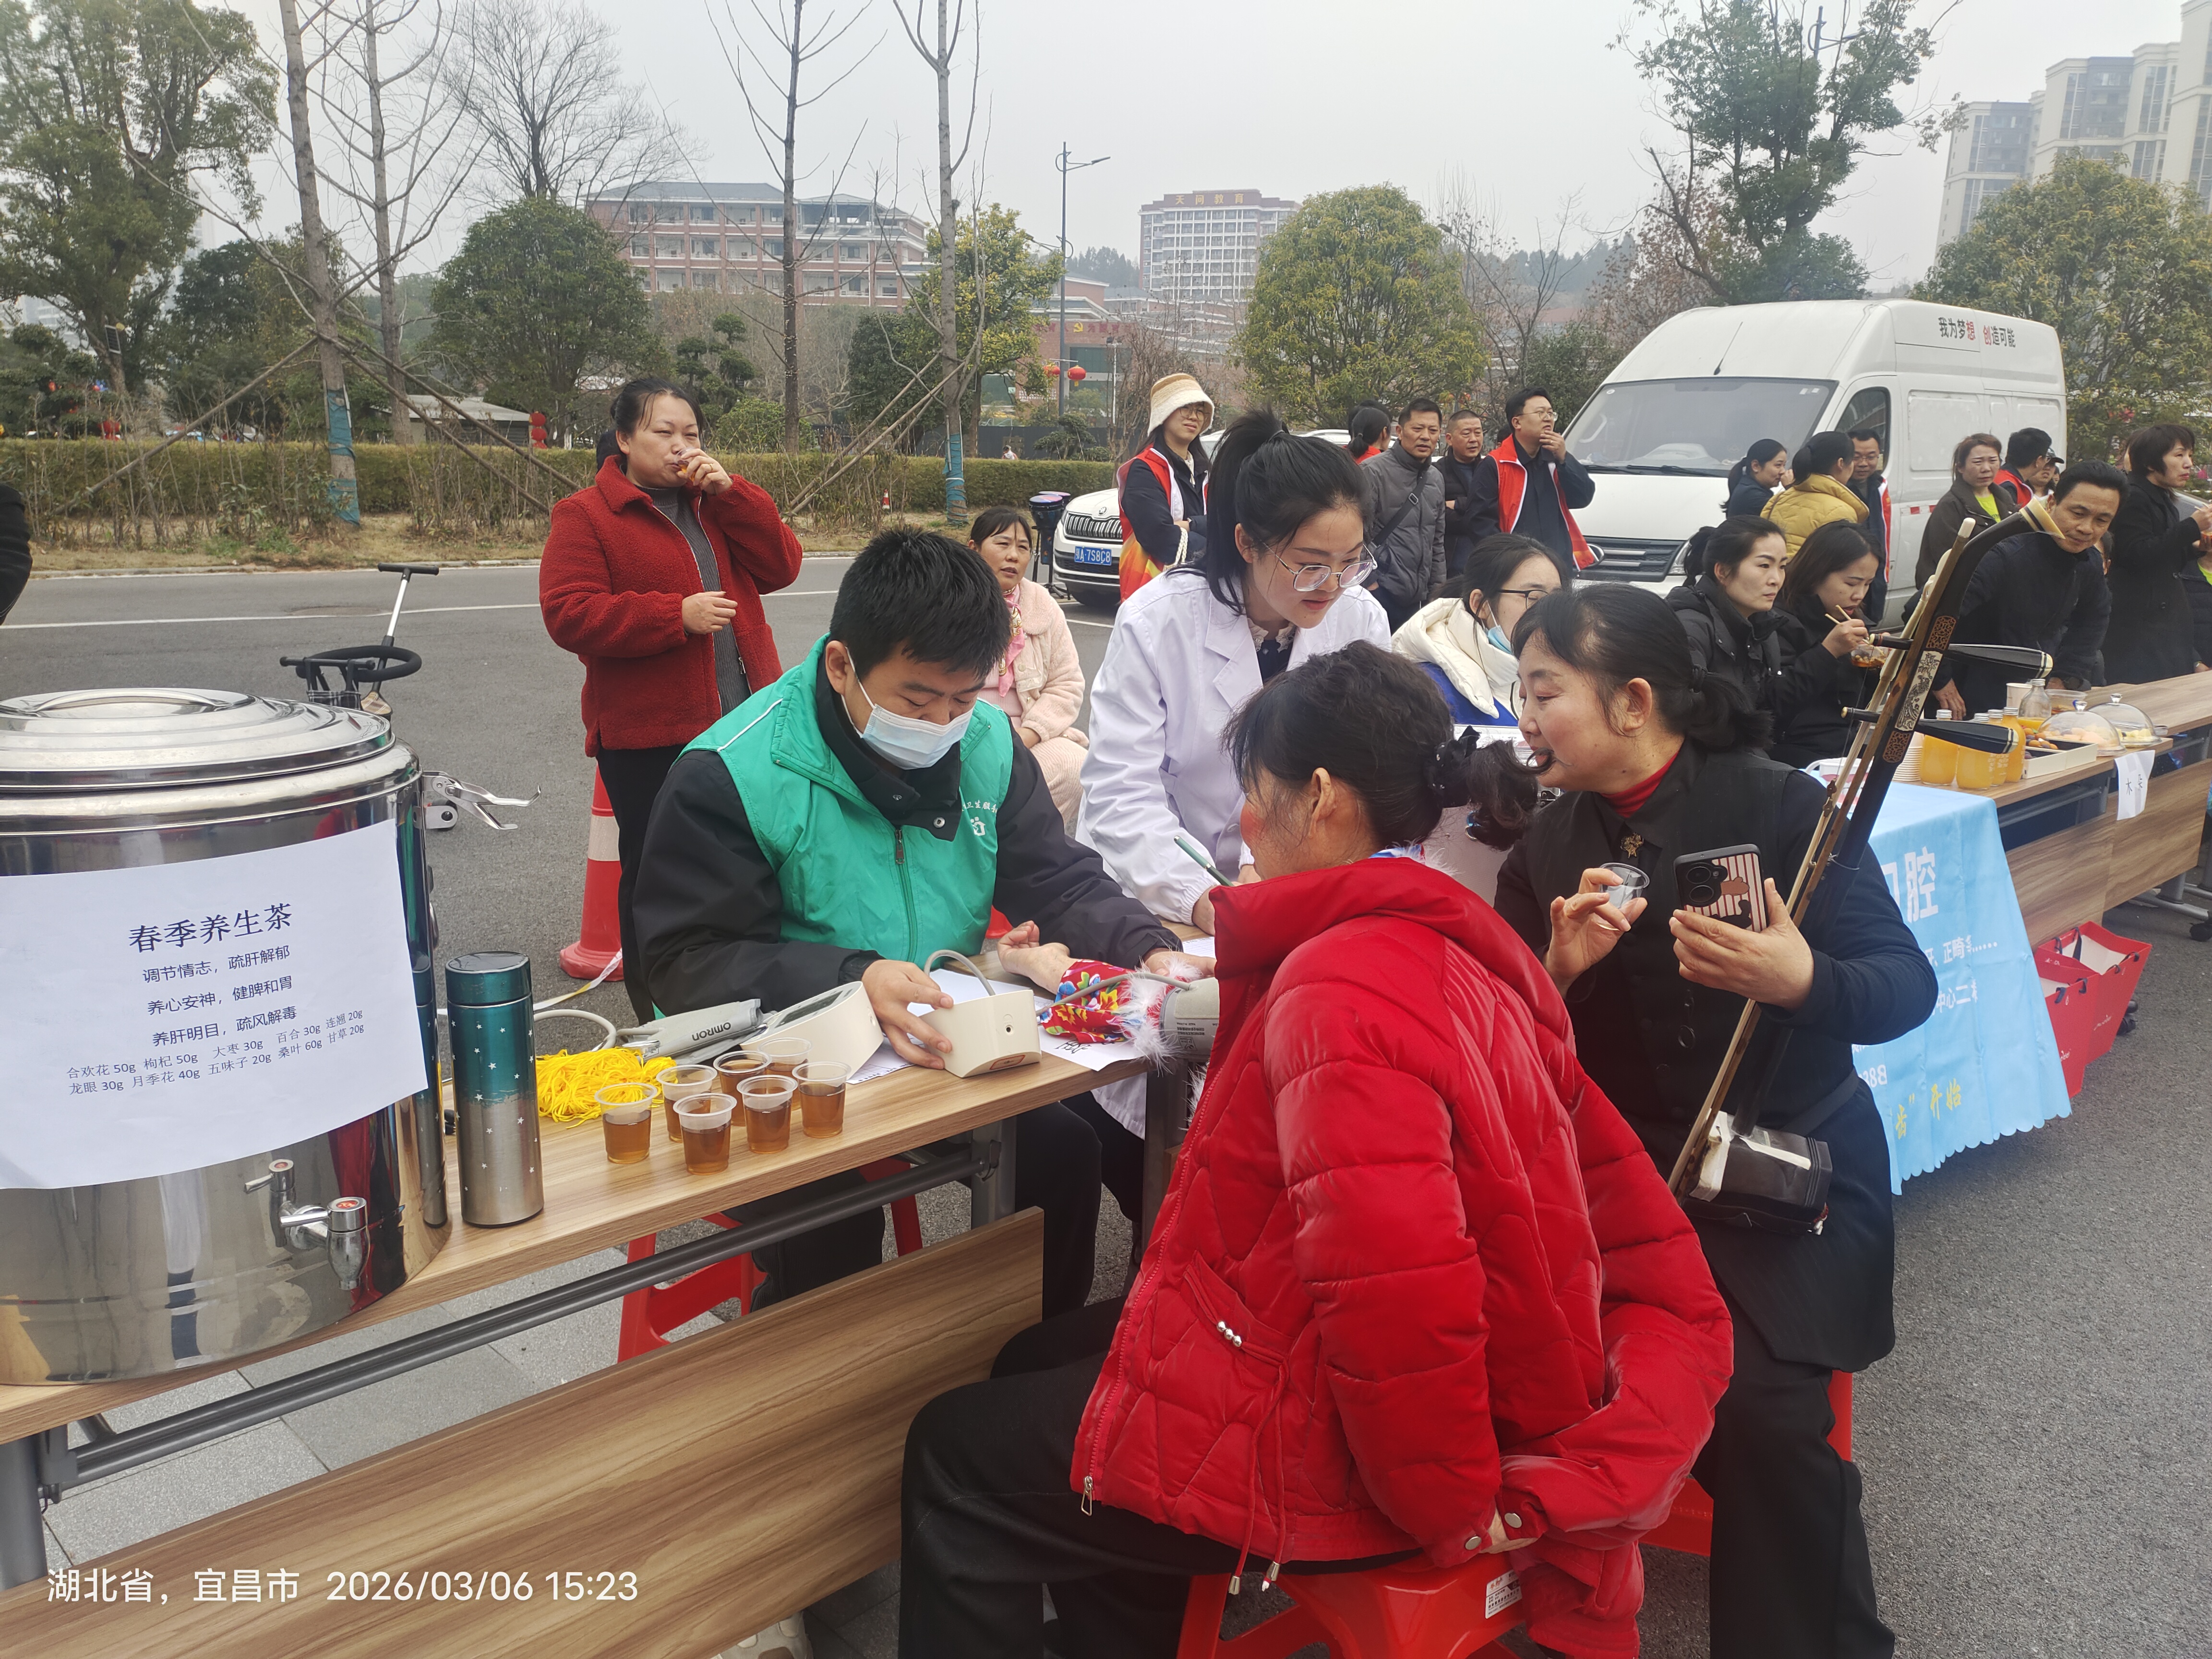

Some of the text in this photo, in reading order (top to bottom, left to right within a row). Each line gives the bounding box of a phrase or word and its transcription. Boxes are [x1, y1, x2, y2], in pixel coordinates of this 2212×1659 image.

[1175, 193, 1244, 205] 天问教育
[1937, 316, 2016, 348] 我为梦想 创造可能
[128, 903, 292, 953] 春季养生茶
[142, 945, 290, 983] 调节情志，疏肝解郁
[147, 975, 292, 1015] 养心安神，健脾和胃
[67, 1009, 363, 1079] 合欢花 50g 枸杞 50g 大枣 30g 百合 30g 连翘 20g
[152, 1006, 297, 1046] 养肝明目，疏风解毒
[692, 1022, 731, 1041] OMRON
[68, 1024, 364, 1095] 龙眼 30g 月季花 40g 五味子 20g 桑叶 60g 甘草 20g
